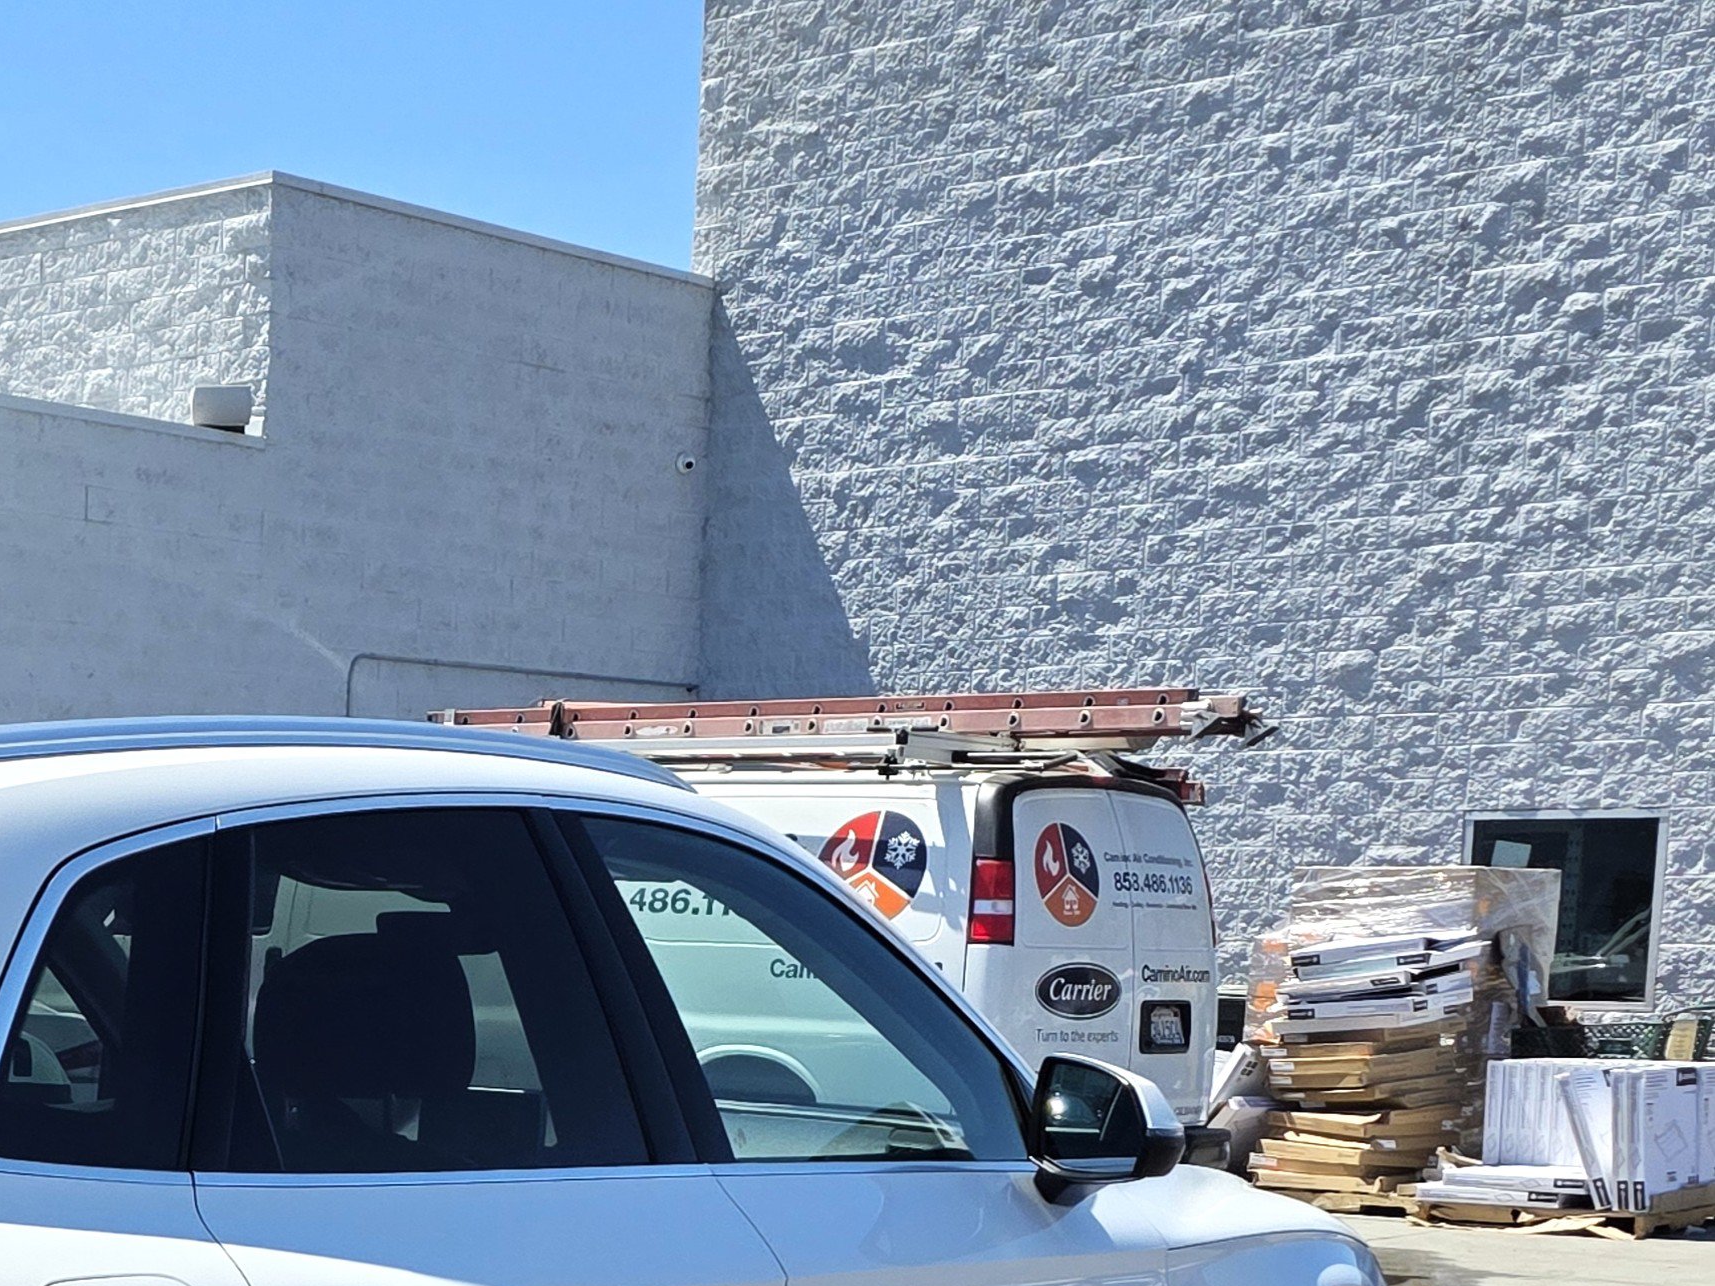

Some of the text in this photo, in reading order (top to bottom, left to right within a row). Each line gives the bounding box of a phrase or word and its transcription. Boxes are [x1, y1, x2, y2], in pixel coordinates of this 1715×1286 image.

[1049, 977, 1112, 1001] Carrier
[1036, 1029, 1119, 1044] Turn to the experts
